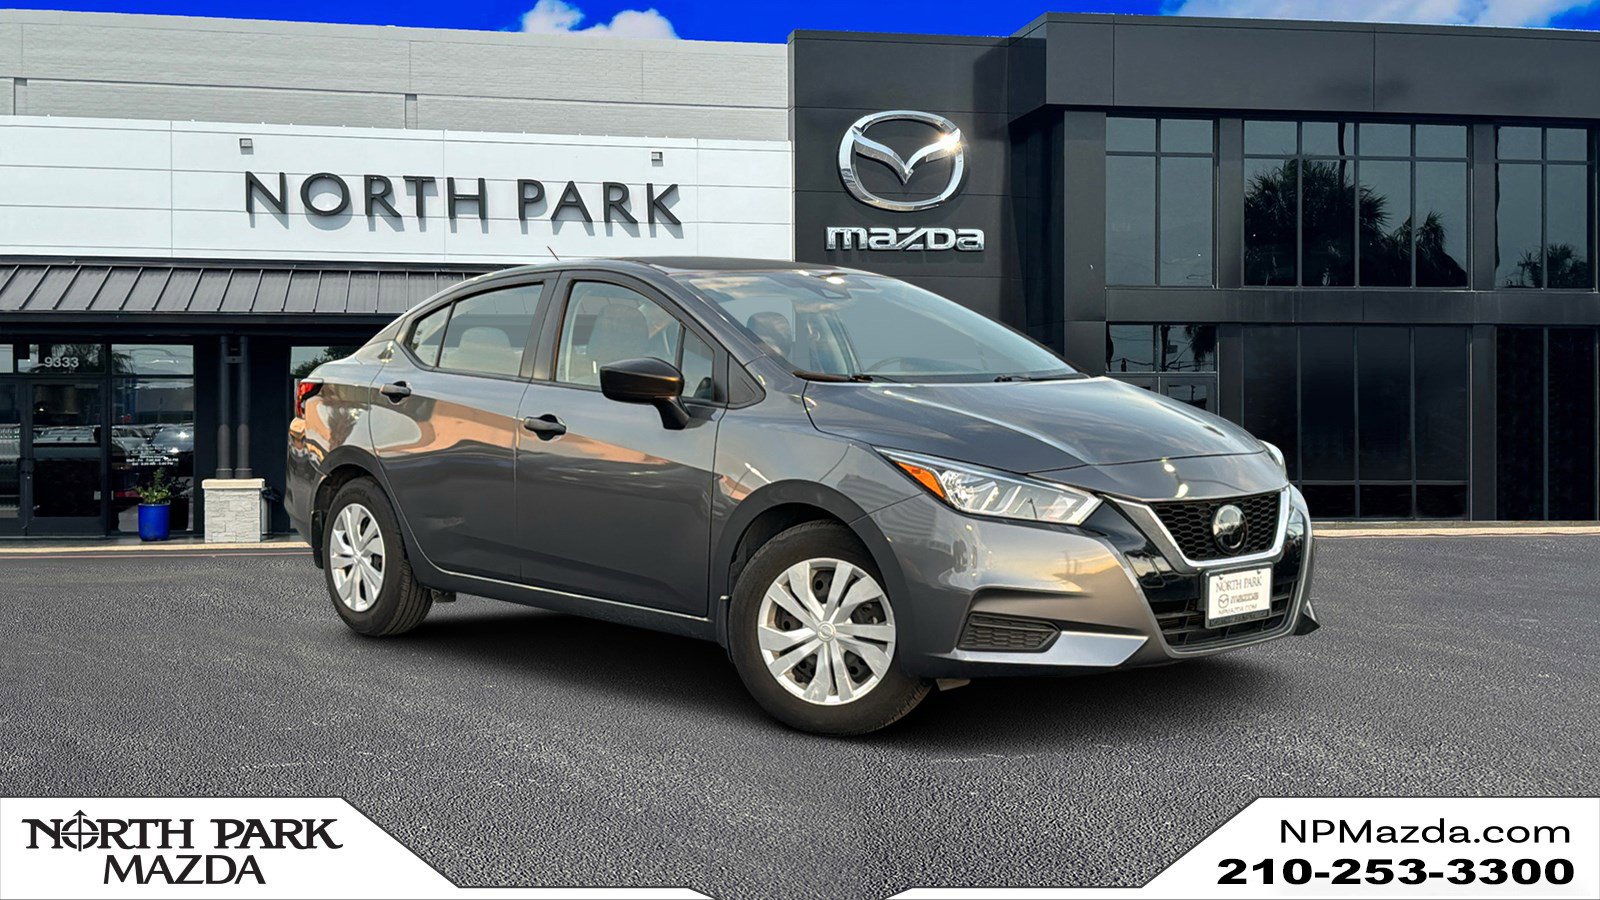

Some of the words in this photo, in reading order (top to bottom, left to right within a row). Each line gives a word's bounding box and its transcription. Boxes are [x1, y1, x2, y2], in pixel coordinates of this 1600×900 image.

[245, 171, 486, 219] NORTH
[517, 178, 682, 225] PARK
[44, 356, 79, 368] 9333
[1215, 579, 1242, 593] NORTH
[1243, 576, 1262, 589] PARK
